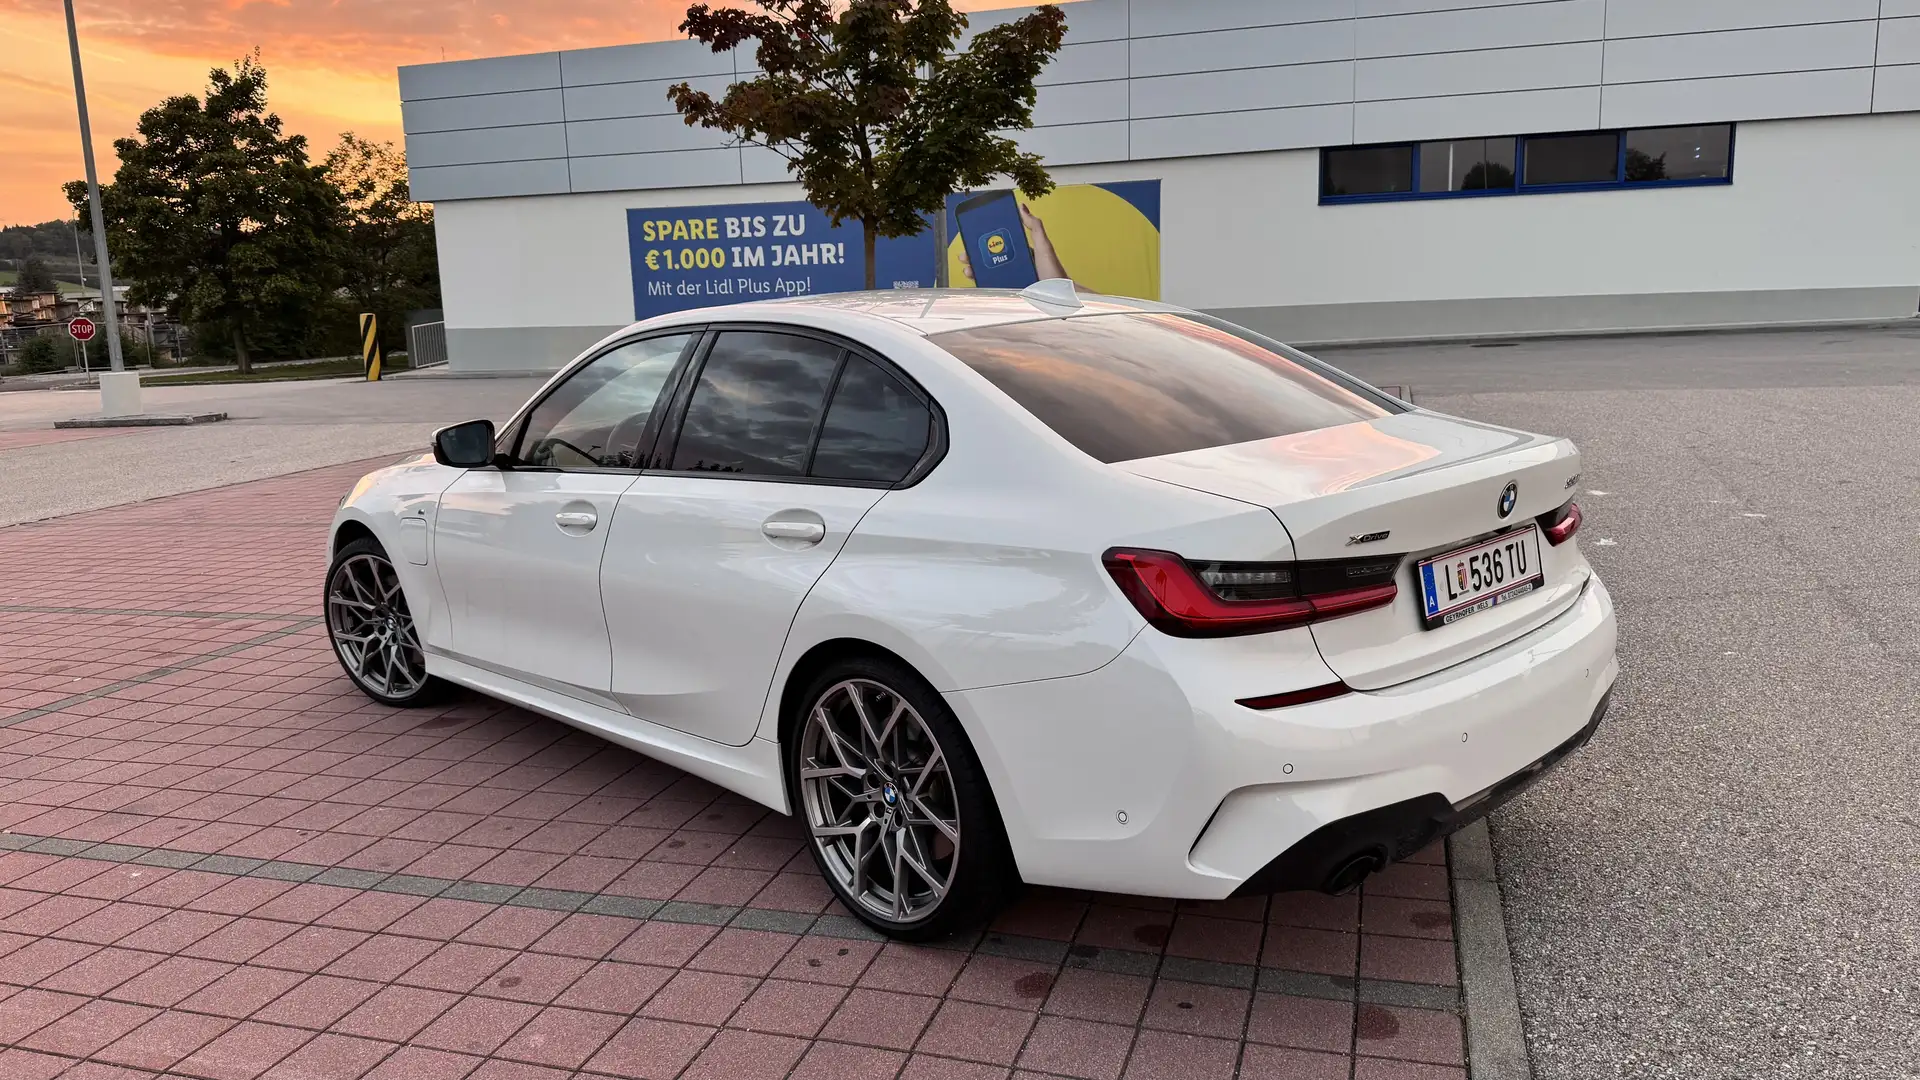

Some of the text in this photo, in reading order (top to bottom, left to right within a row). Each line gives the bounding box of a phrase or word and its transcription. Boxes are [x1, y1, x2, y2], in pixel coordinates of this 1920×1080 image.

[643, 214, 806, 242] SPARE BIS ZU
[731, 245, 765, 268] IM
[771, 242, 845, 267] JAHR!
[992, 255, 1008, 264] Plus
[648, 276, 811, 296] Mit der Lidl Plus App!
[71, 325, 92, 334] STOP
[1445, 564, 1458, 601] L
[1429, 596, 1436, 608] A
